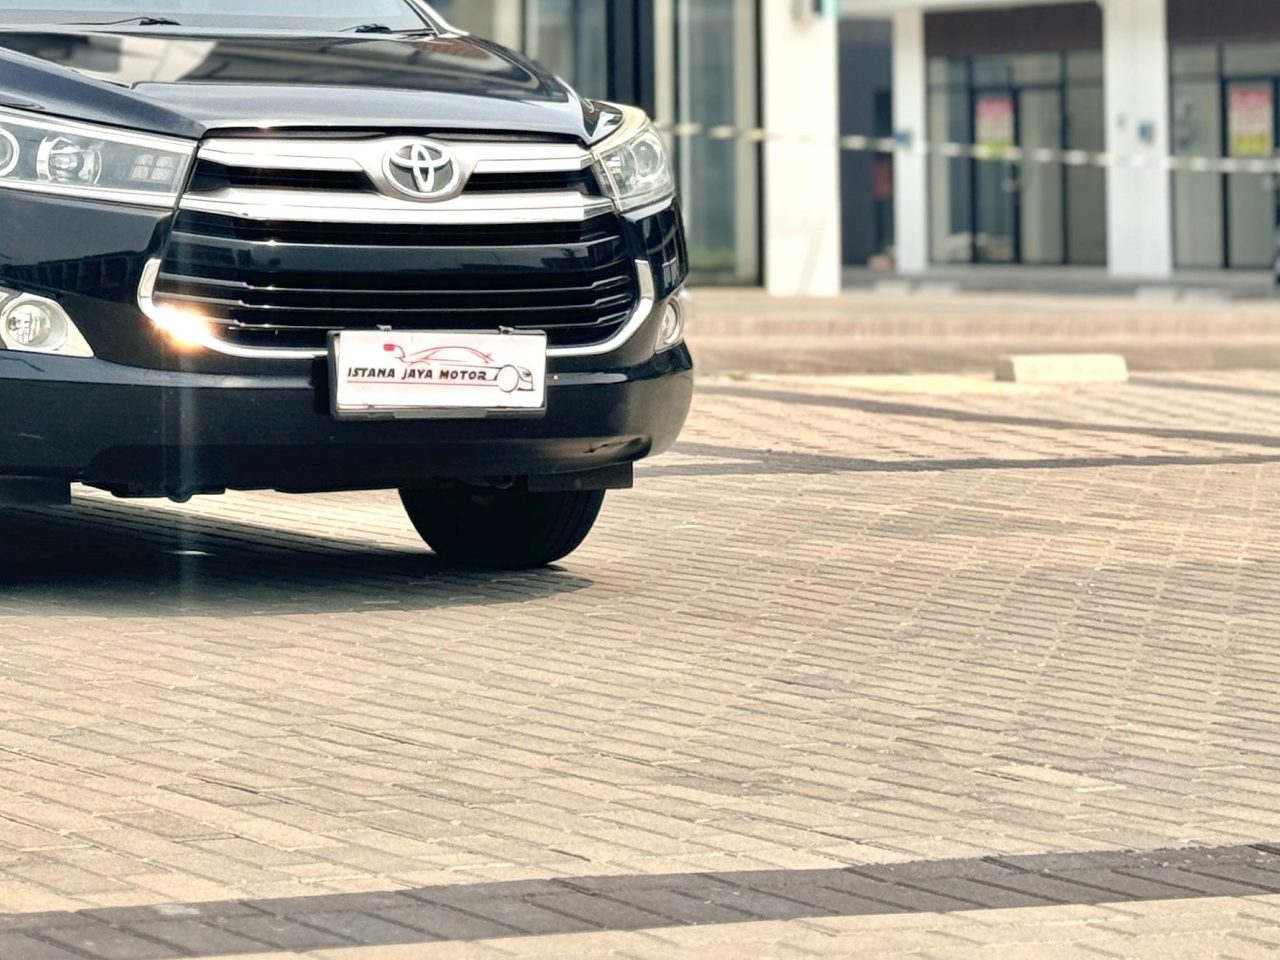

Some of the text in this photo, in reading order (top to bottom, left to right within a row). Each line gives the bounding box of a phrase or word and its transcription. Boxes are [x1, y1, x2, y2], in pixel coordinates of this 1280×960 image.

[347, 367, 487, 381] ISTANA JAYA MOTOR
